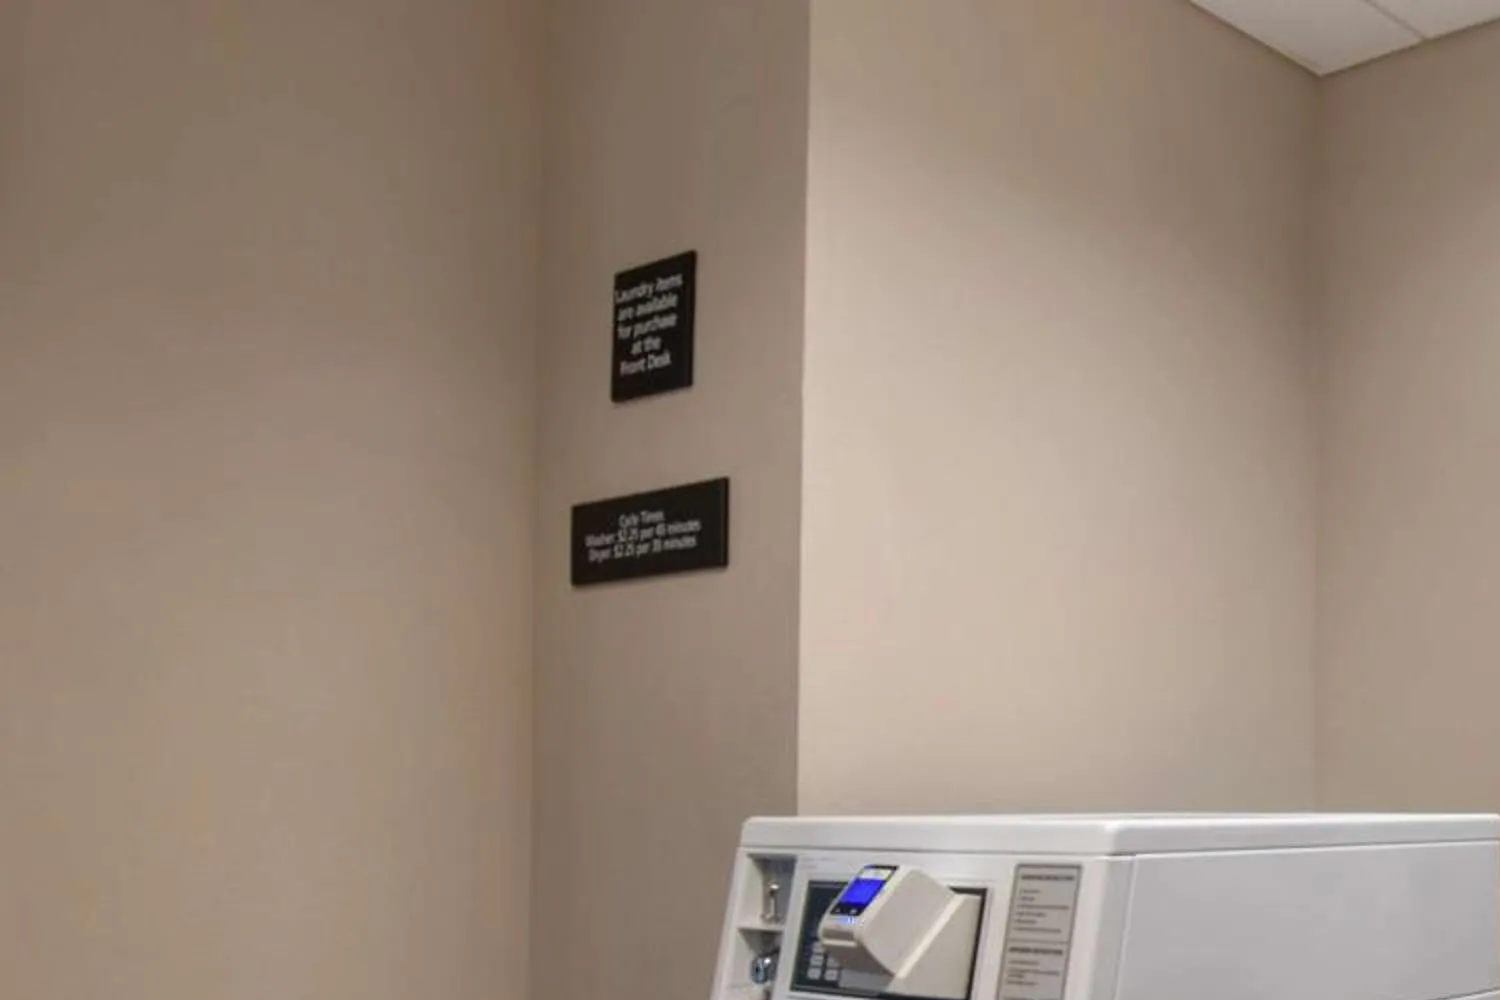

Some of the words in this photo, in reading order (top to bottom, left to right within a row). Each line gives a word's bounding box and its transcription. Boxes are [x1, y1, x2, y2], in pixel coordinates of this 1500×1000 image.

[614, 282, 654, 304] Laundry
[618, 306, 635, 321] are
[636, 292, 678, 317] available
[618, 323, 632, 339] for
[633, 313, 678, 339] purchase
[631, 341, 642, 355] at
[643, 336, 661, 352] the
[620, 358, 646, 376] Front
[647, 349, 671, 370] Desk
[668, 519, 702, 535] minutes
[663, 535, 697, 551] minutes
